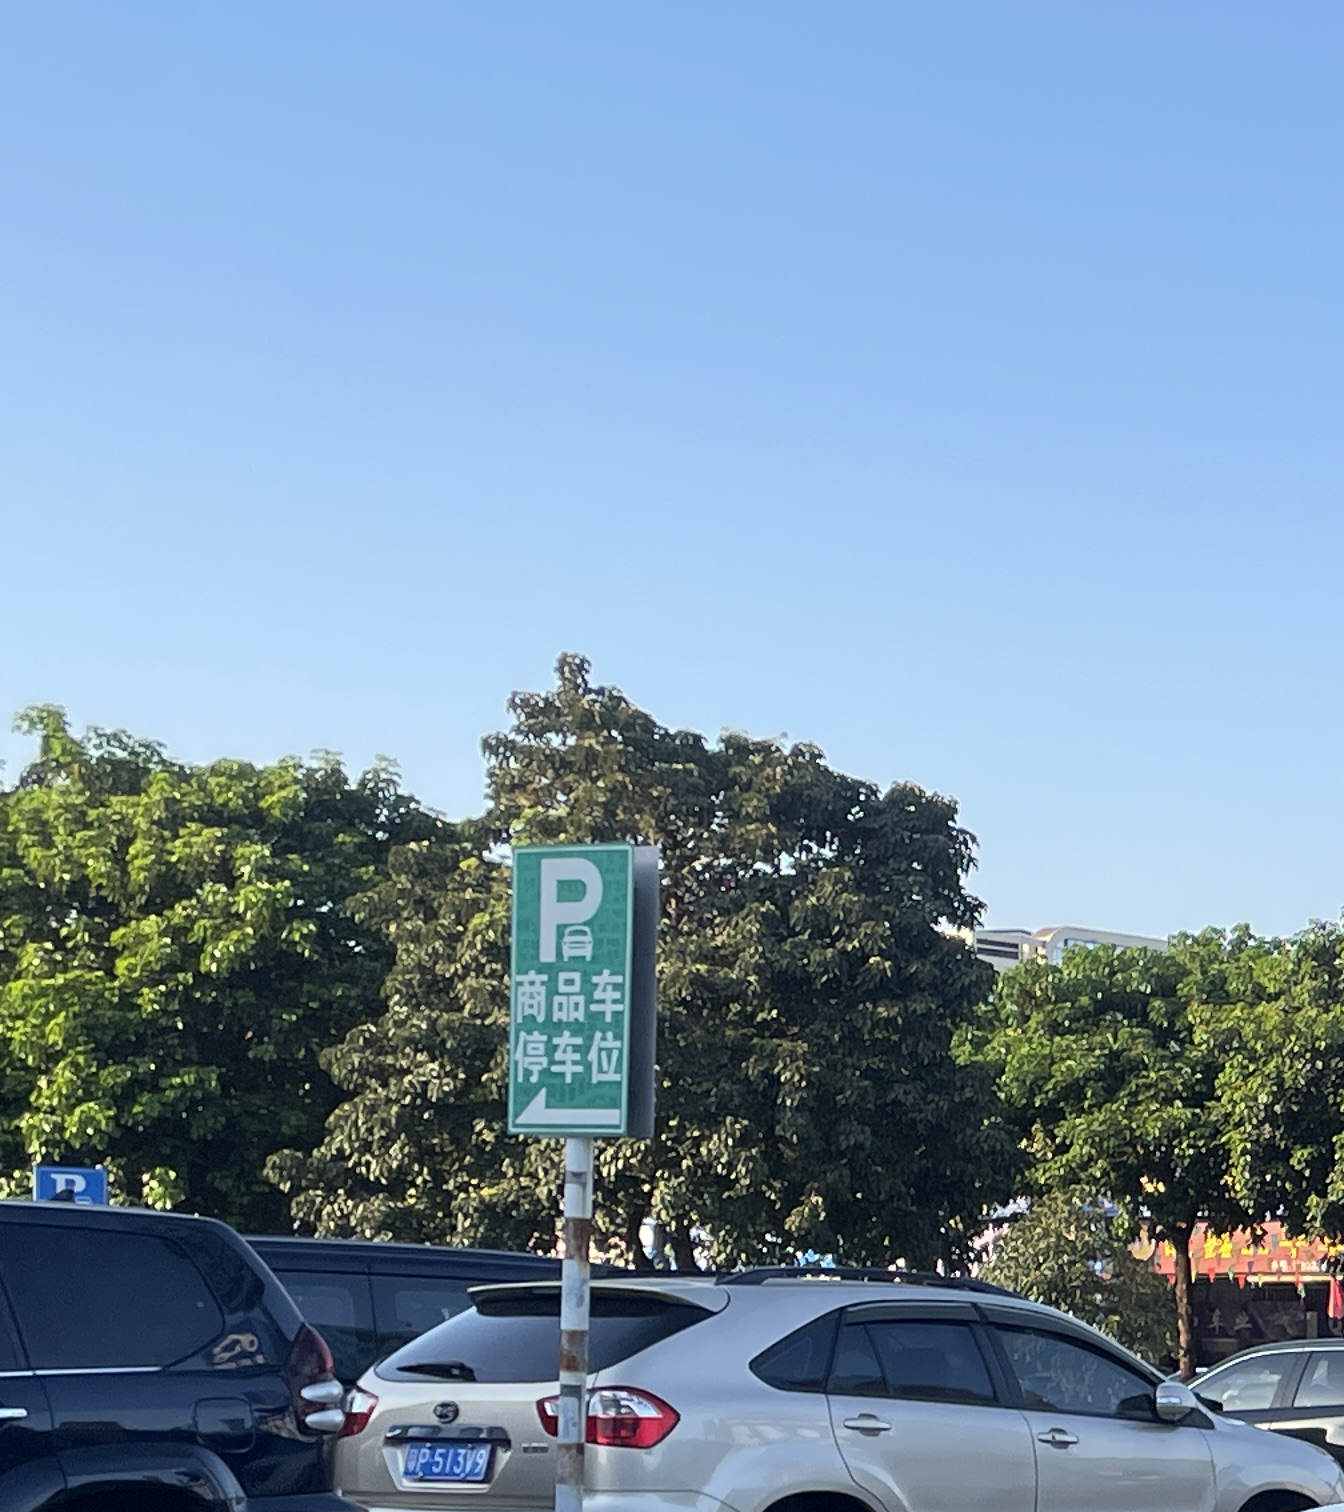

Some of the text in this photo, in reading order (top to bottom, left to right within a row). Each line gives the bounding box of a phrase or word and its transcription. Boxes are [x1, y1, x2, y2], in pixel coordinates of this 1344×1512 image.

[539, 857, 604, 963] P
[514, 969, 625, 1024] 商品车
[514, 1030, 623, 1084] 停车位
